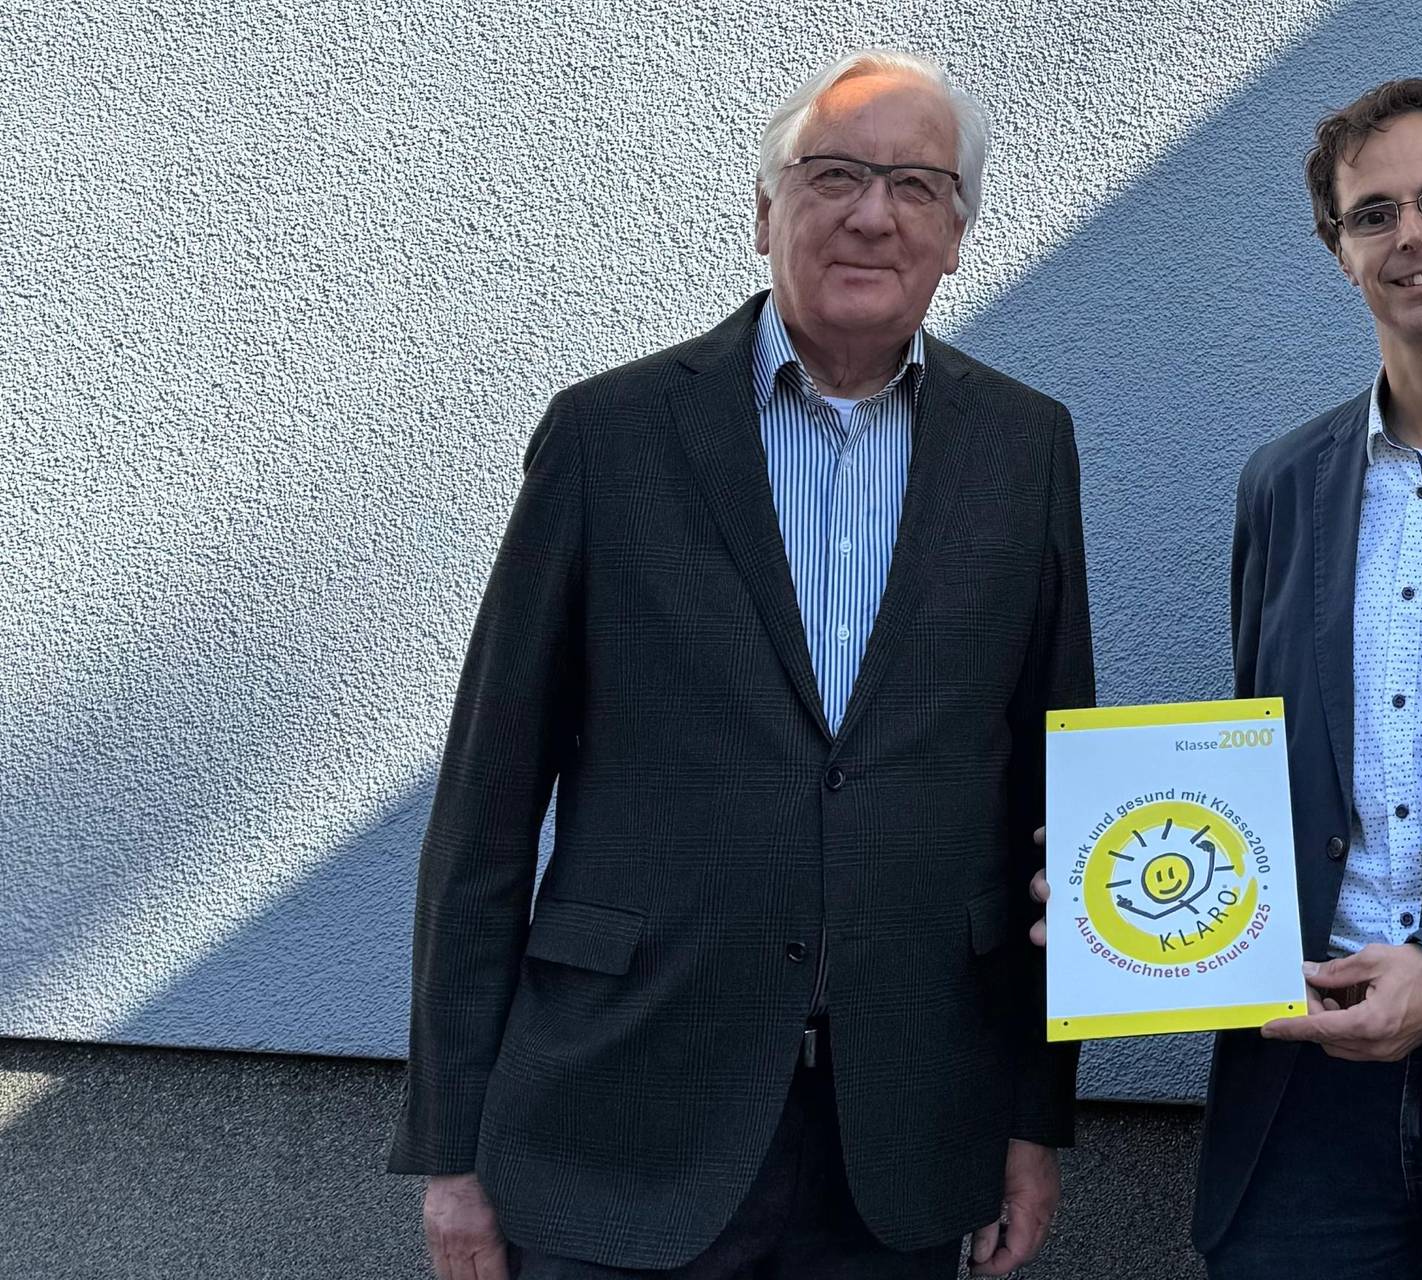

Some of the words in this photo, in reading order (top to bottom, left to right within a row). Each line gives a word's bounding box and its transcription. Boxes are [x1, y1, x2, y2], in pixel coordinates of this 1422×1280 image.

[1069, 844, 1092, 886] Stark
[1089, 812, 1115, 841] und
[1116, 788, 1175, 818] gesund
[1181, 789, 1207, 804] mit
[1210, 797, 1270, 874] Klasse2000
[1075, 917, 1190, 978] Ausgezeichnete
[1196, 940, 1249, 973] Schule
[1247, 904, 1271, 940] 2025
[1160, 890, 1237, 952] KLARO
